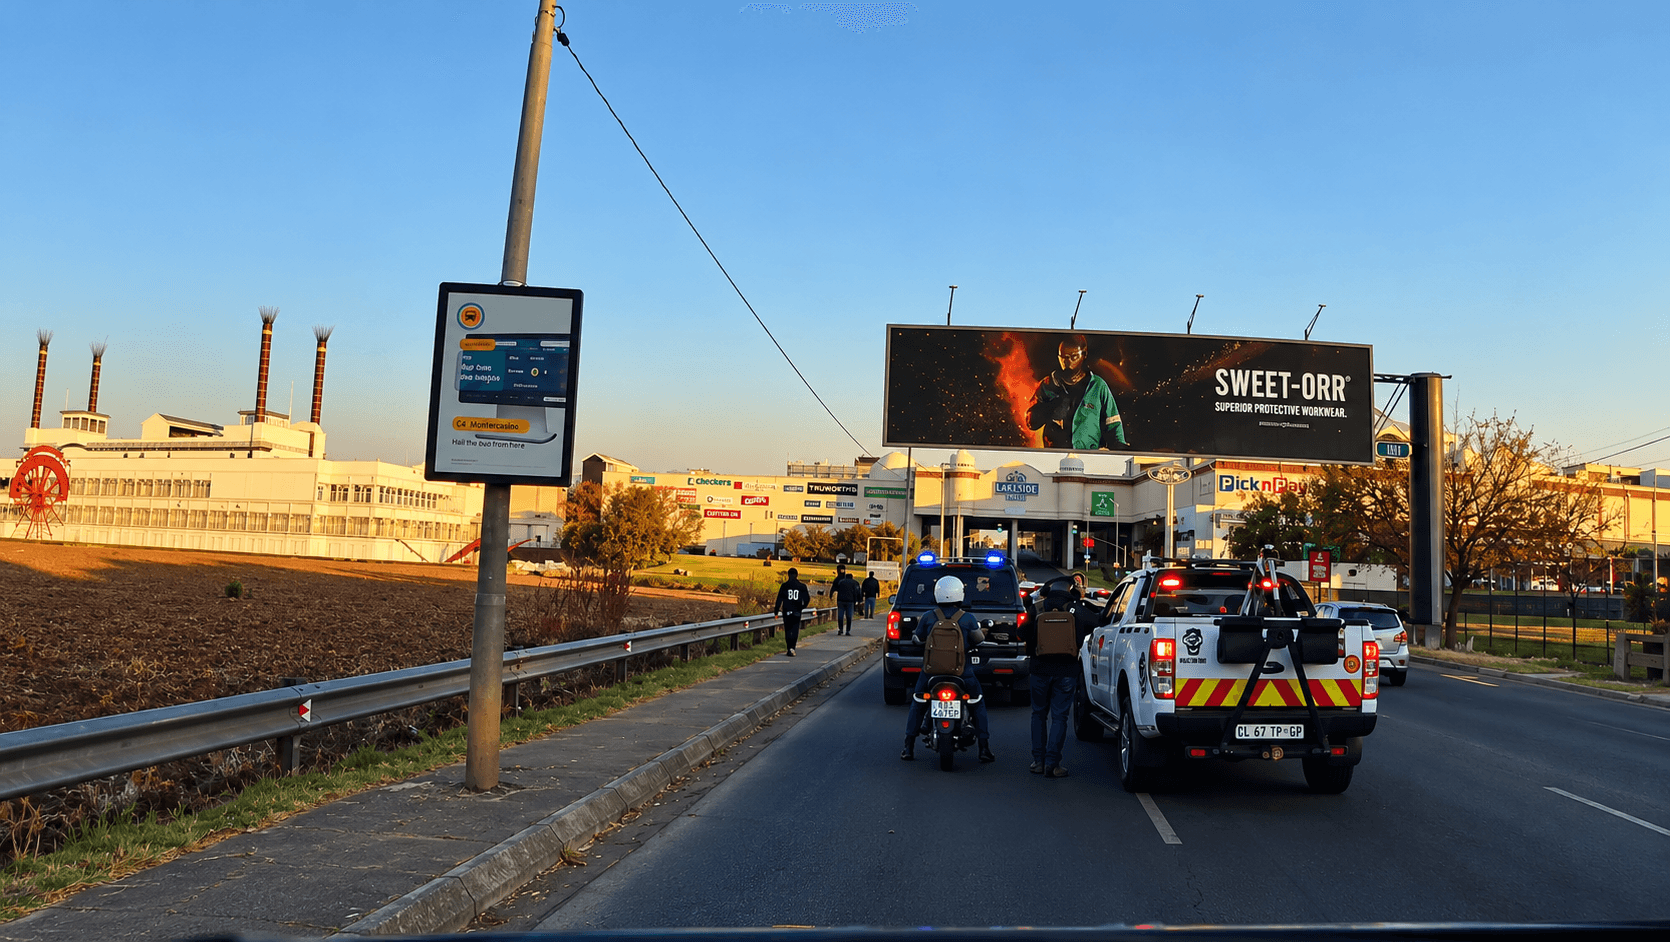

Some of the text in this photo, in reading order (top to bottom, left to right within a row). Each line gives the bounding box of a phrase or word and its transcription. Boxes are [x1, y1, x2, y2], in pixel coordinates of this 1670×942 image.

[1215, 402, 1348, 418] SUPERIOR PROTECTIVE WORKWEAR.
[696, 478, 732, 486] Checkers
[1219, 475, 1260, 492] Pick
[1262, 480, 1271, 491] n
[1238, 726, 1302, 737] CL 67 TP GP
